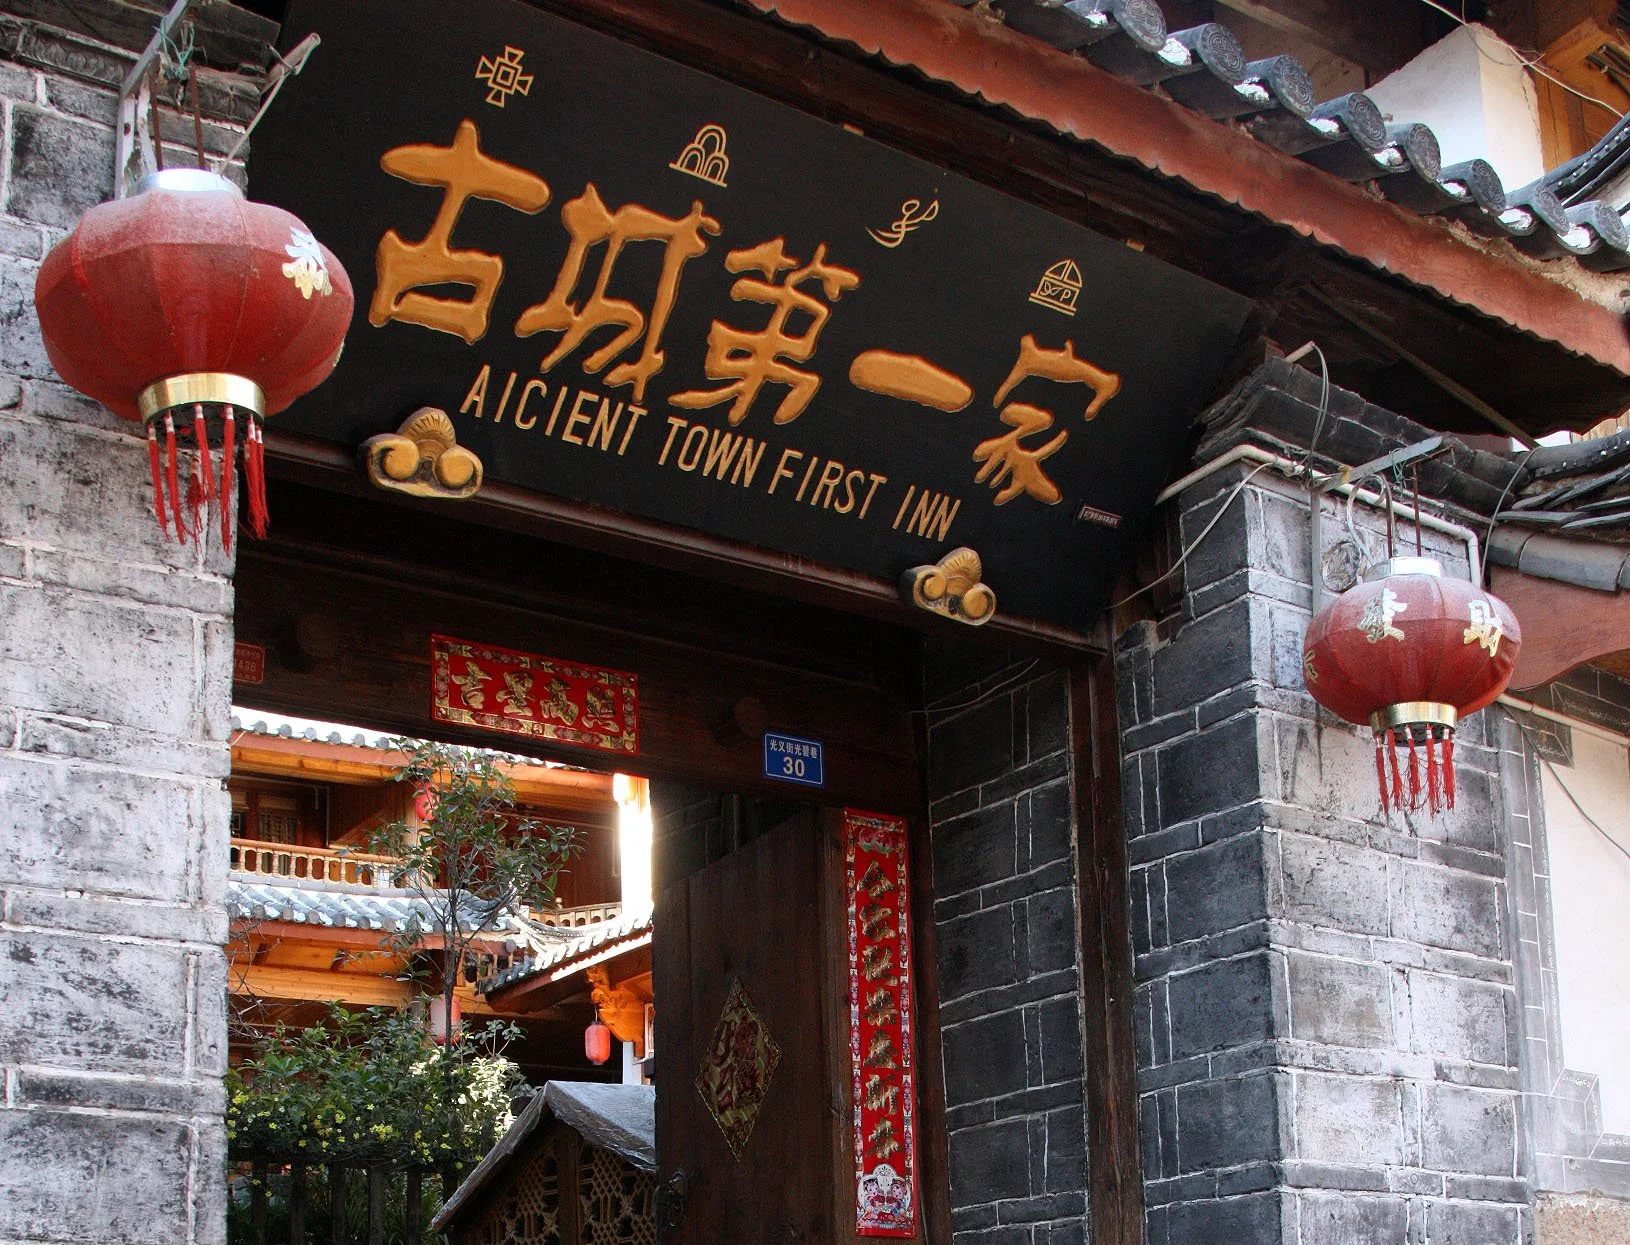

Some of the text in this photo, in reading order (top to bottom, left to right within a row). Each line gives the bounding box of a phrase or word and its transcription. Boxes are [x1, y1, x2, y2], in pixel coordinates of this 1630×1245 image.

[369, 118, 1123, 506] 古城第一家
[460, 364, 961, 543] AICIENT TOWN FIRST INN
[451, 660, 620, 733] 吉星高照
[783, 756, 805, 777] 30
